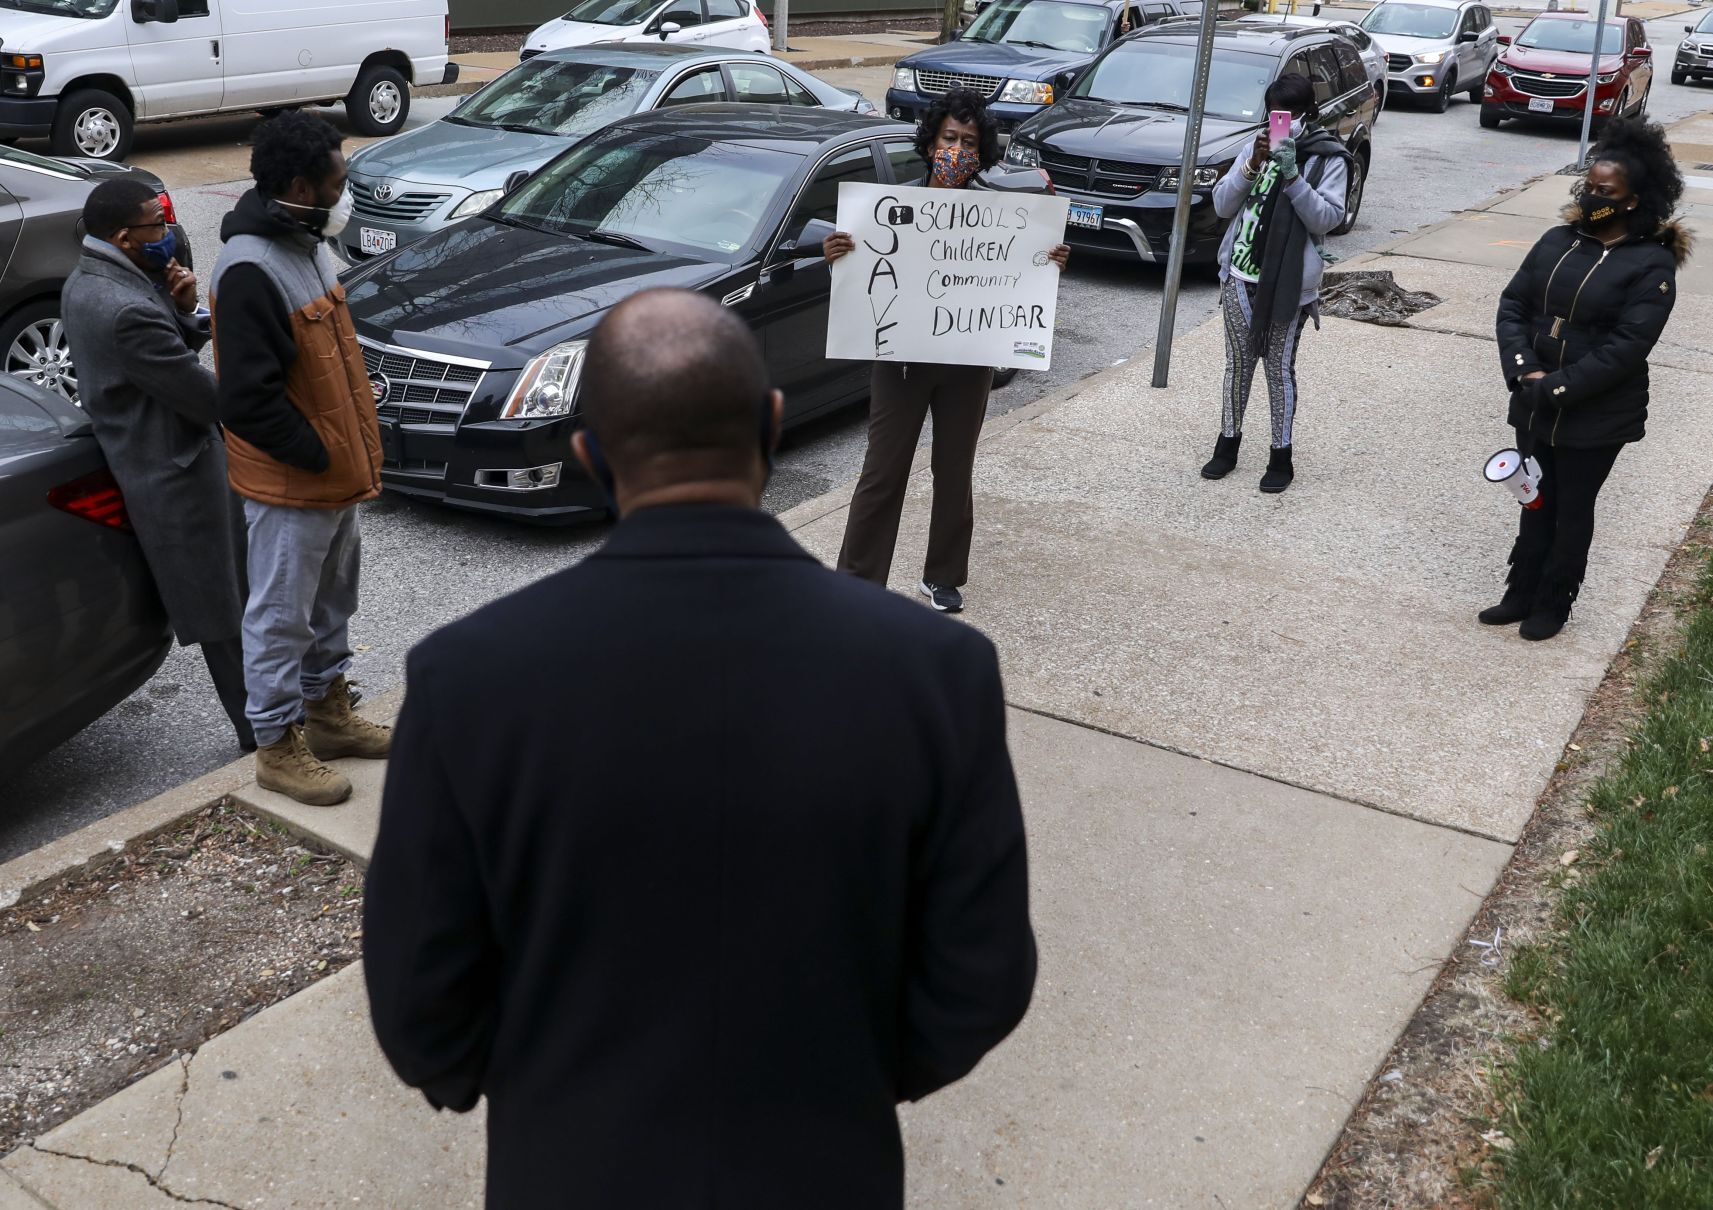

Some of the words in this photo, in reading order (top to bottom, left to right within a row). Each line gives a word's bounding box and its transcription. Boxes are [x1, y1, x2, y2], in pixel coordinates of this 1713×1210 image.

[915, 200, 1029, 233] SCHOOLS
[1076, 210, 1101, 224] 97967
[1590, 208, 1615, 221] TROUBLE
[1591, 206, 1610, 216] GOOD
[864, 195, 899, 358] SAVE
[932, 304, 1047, 337] DUNBAR
